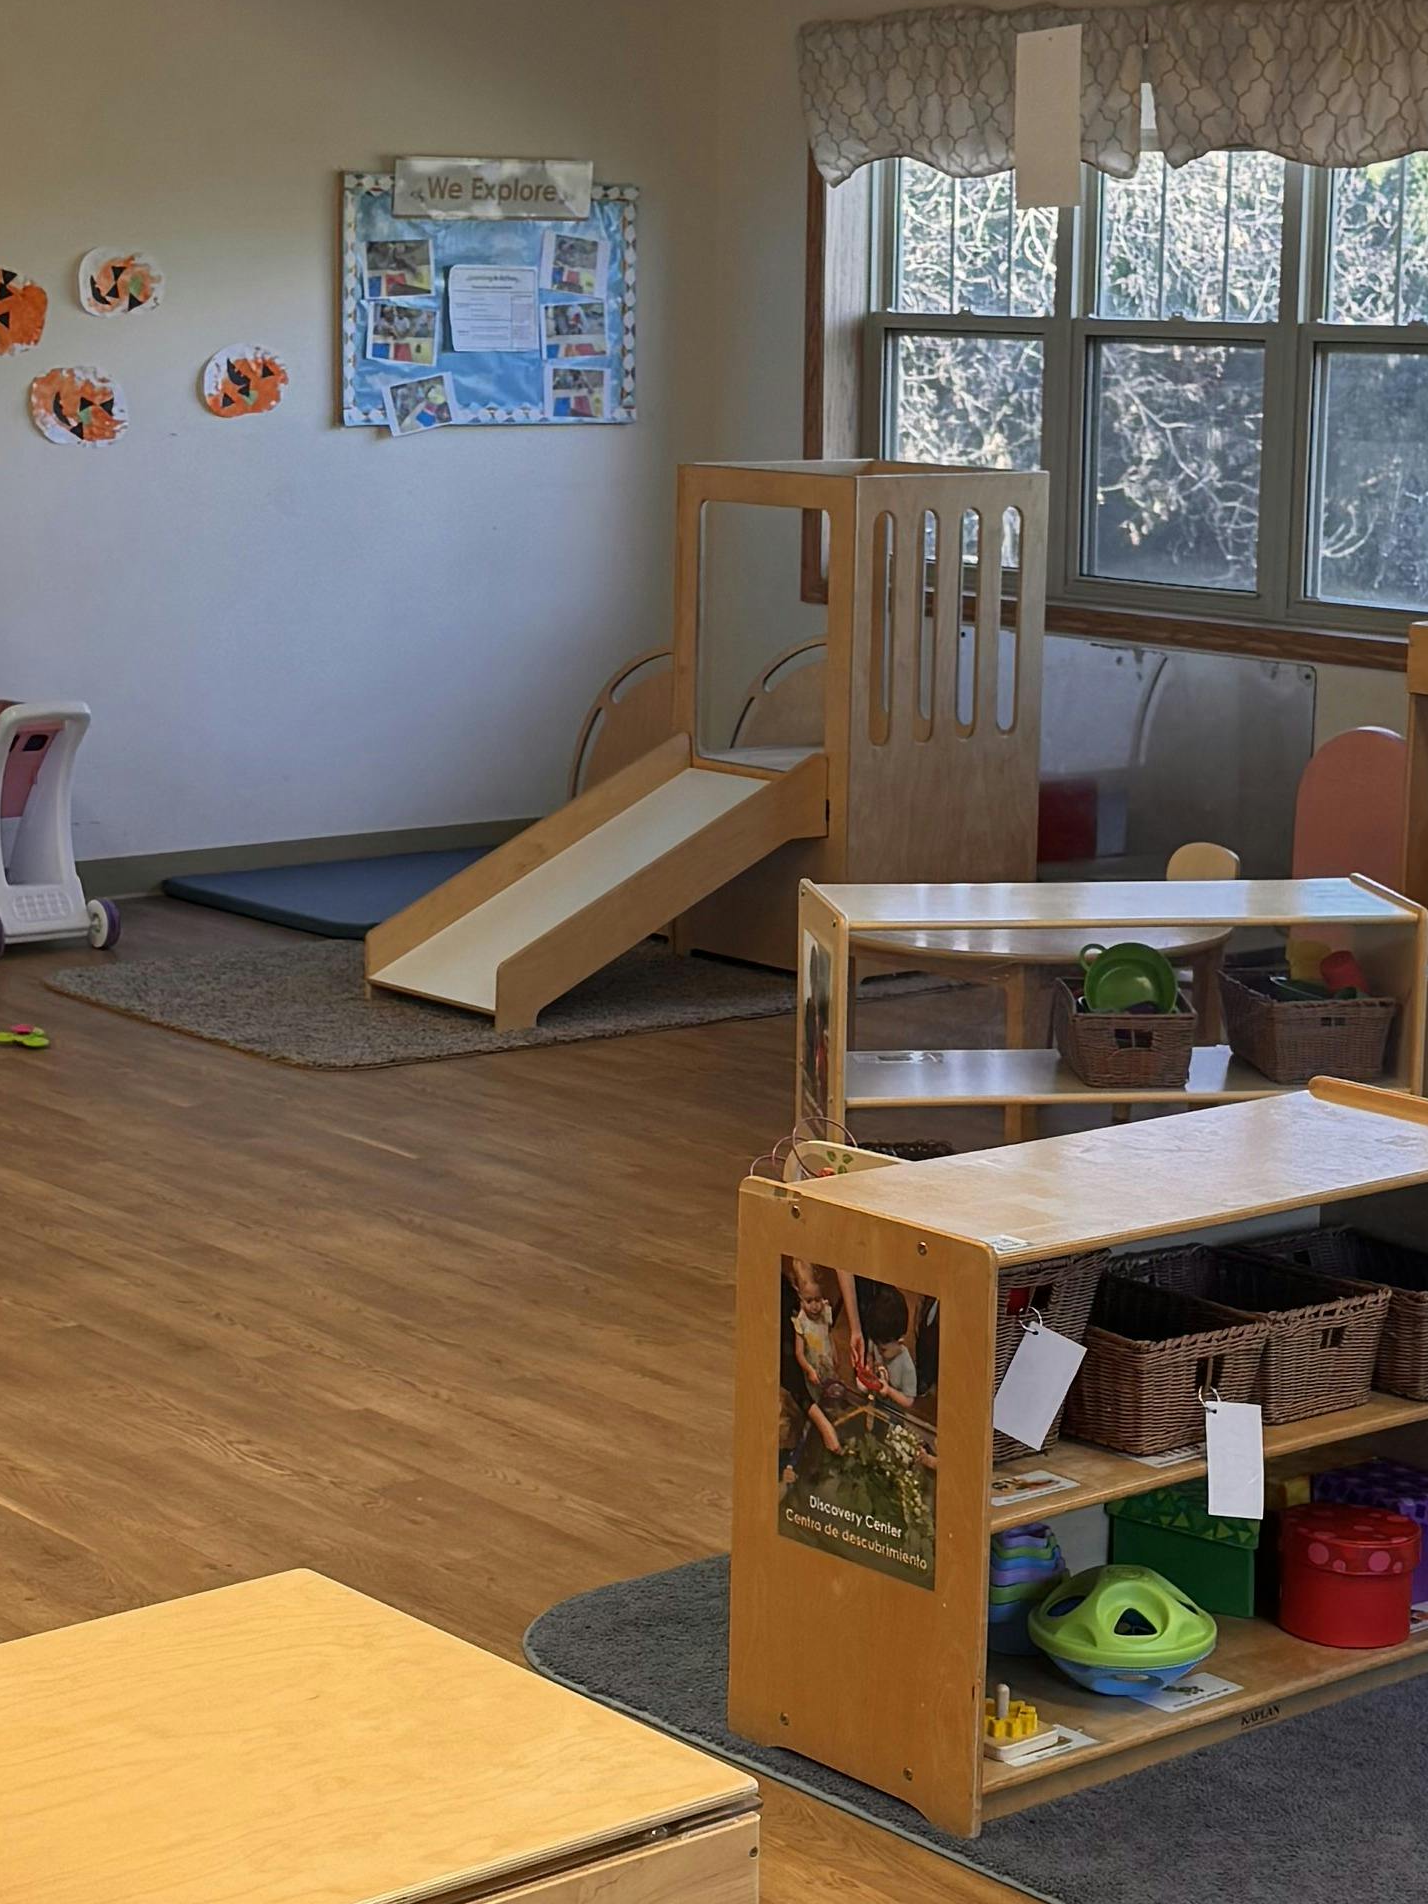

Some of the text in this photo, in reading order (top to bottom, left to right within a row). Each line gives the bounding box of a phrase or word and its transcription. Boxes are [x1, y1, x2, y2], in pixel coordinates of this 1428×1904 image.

[427, 176, 558, 203] We Explore
[809, 1495, 902, 1538] Discovery Center
[785, 1508, 928, 1570] Centro de descubrimiento
[1240, 1705, 1280, 1726] KAPLAN
